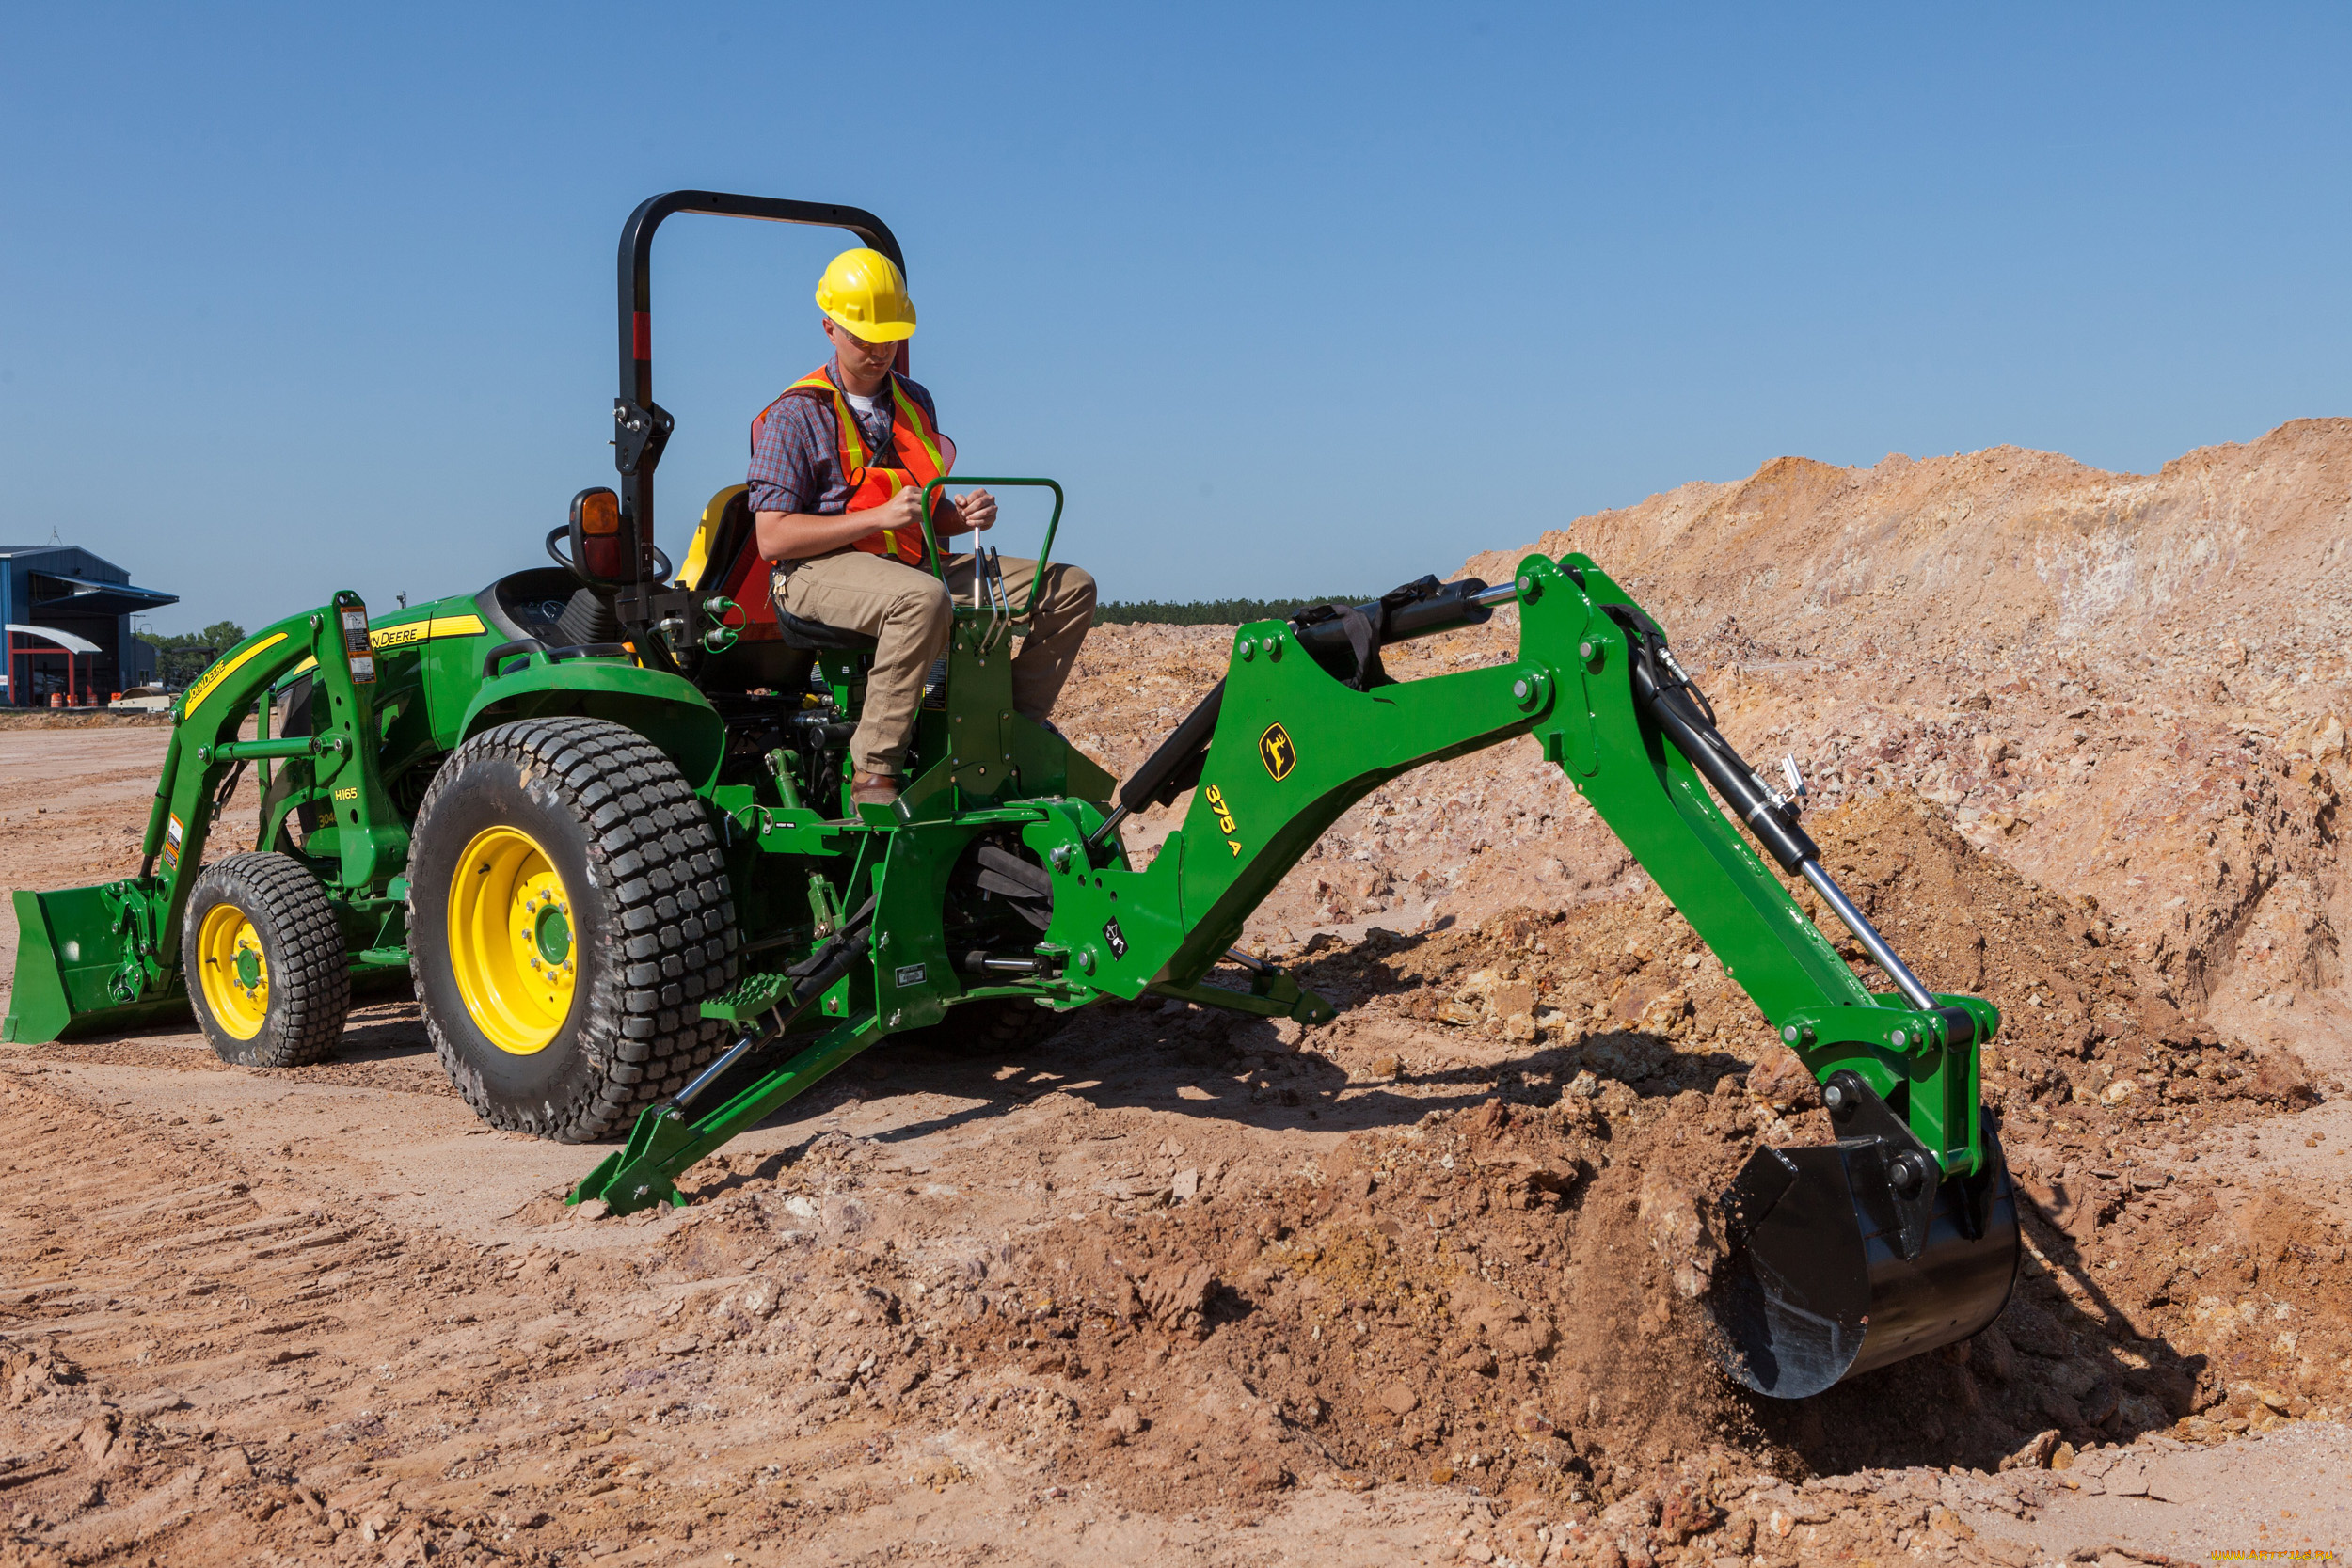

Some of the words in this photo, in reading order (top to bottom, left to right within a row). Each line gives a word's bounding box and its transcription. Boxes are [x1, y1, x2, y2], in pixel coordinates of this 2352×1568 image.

[380, 628, 418, 645] DEERE
[188, 678, 205, 704] JOHN
[202, 659, 226, 688] DEERE
[334, 787, 358, 801] H165
[1205, 784, 1237, 836] 375
[1227, 839, 1242, 859] A
